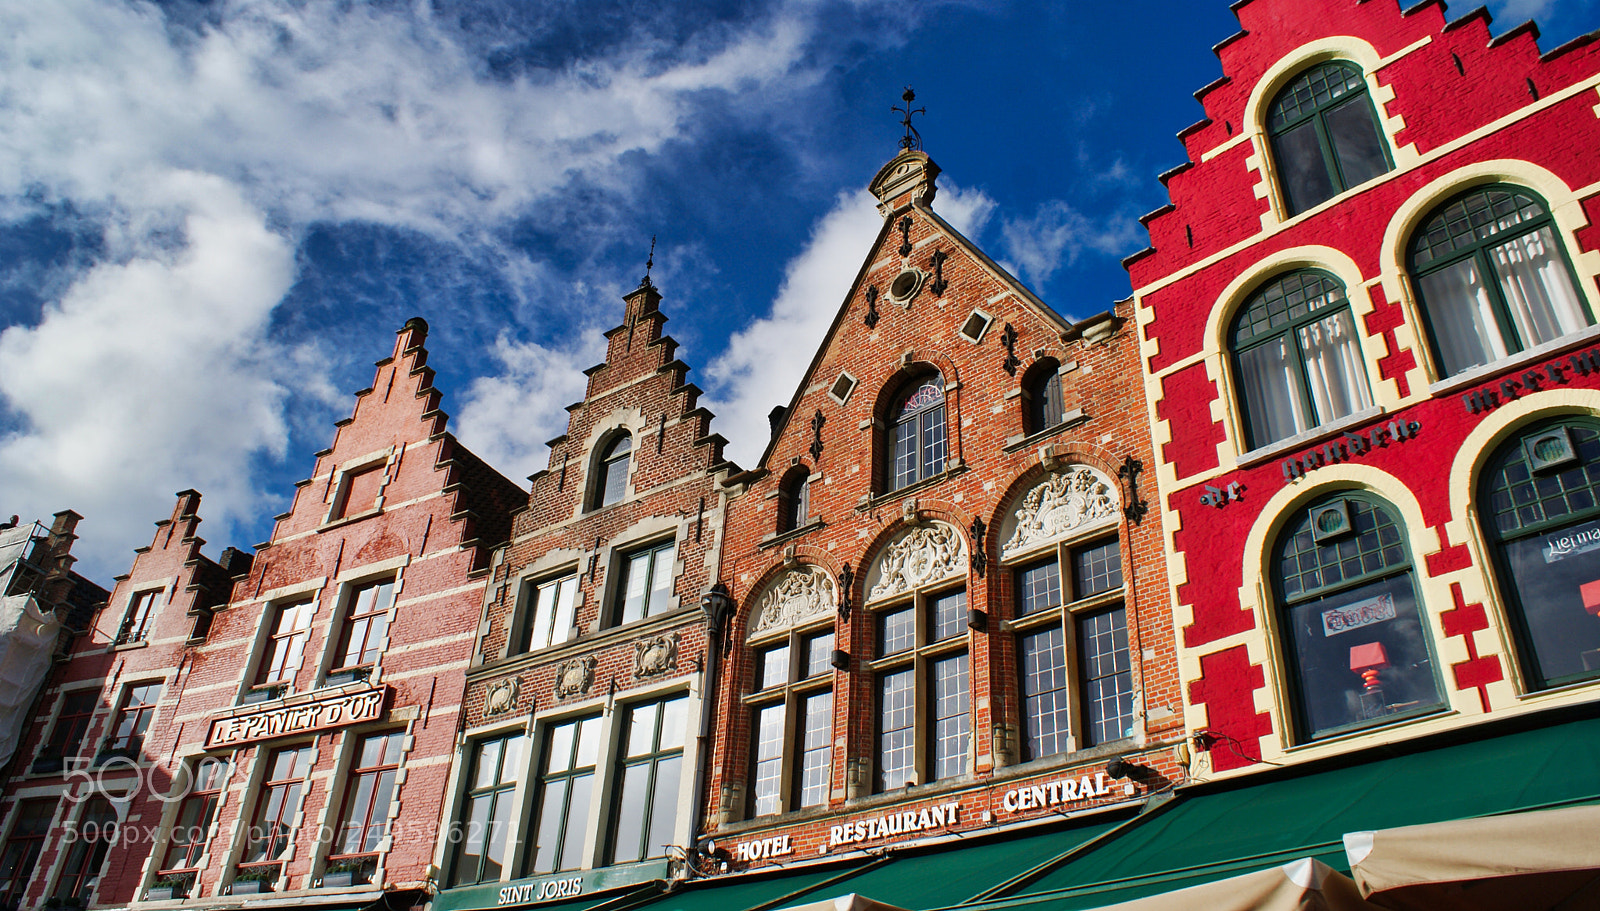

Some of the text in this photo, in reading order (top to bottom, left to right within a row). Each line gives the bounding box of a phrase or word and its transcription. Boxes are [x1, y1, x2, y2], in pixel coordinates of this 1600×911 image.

[1203, 480, 1242, 508] de
[1281, 418, 1411, 484] gouden
[211, 693, 380, 744] LE PANIER D'OR
[737, 772, 1110, 862] HOTEL RESTAURANT CENTRAL
[498, 877, 582, 905] SINT JORIS
